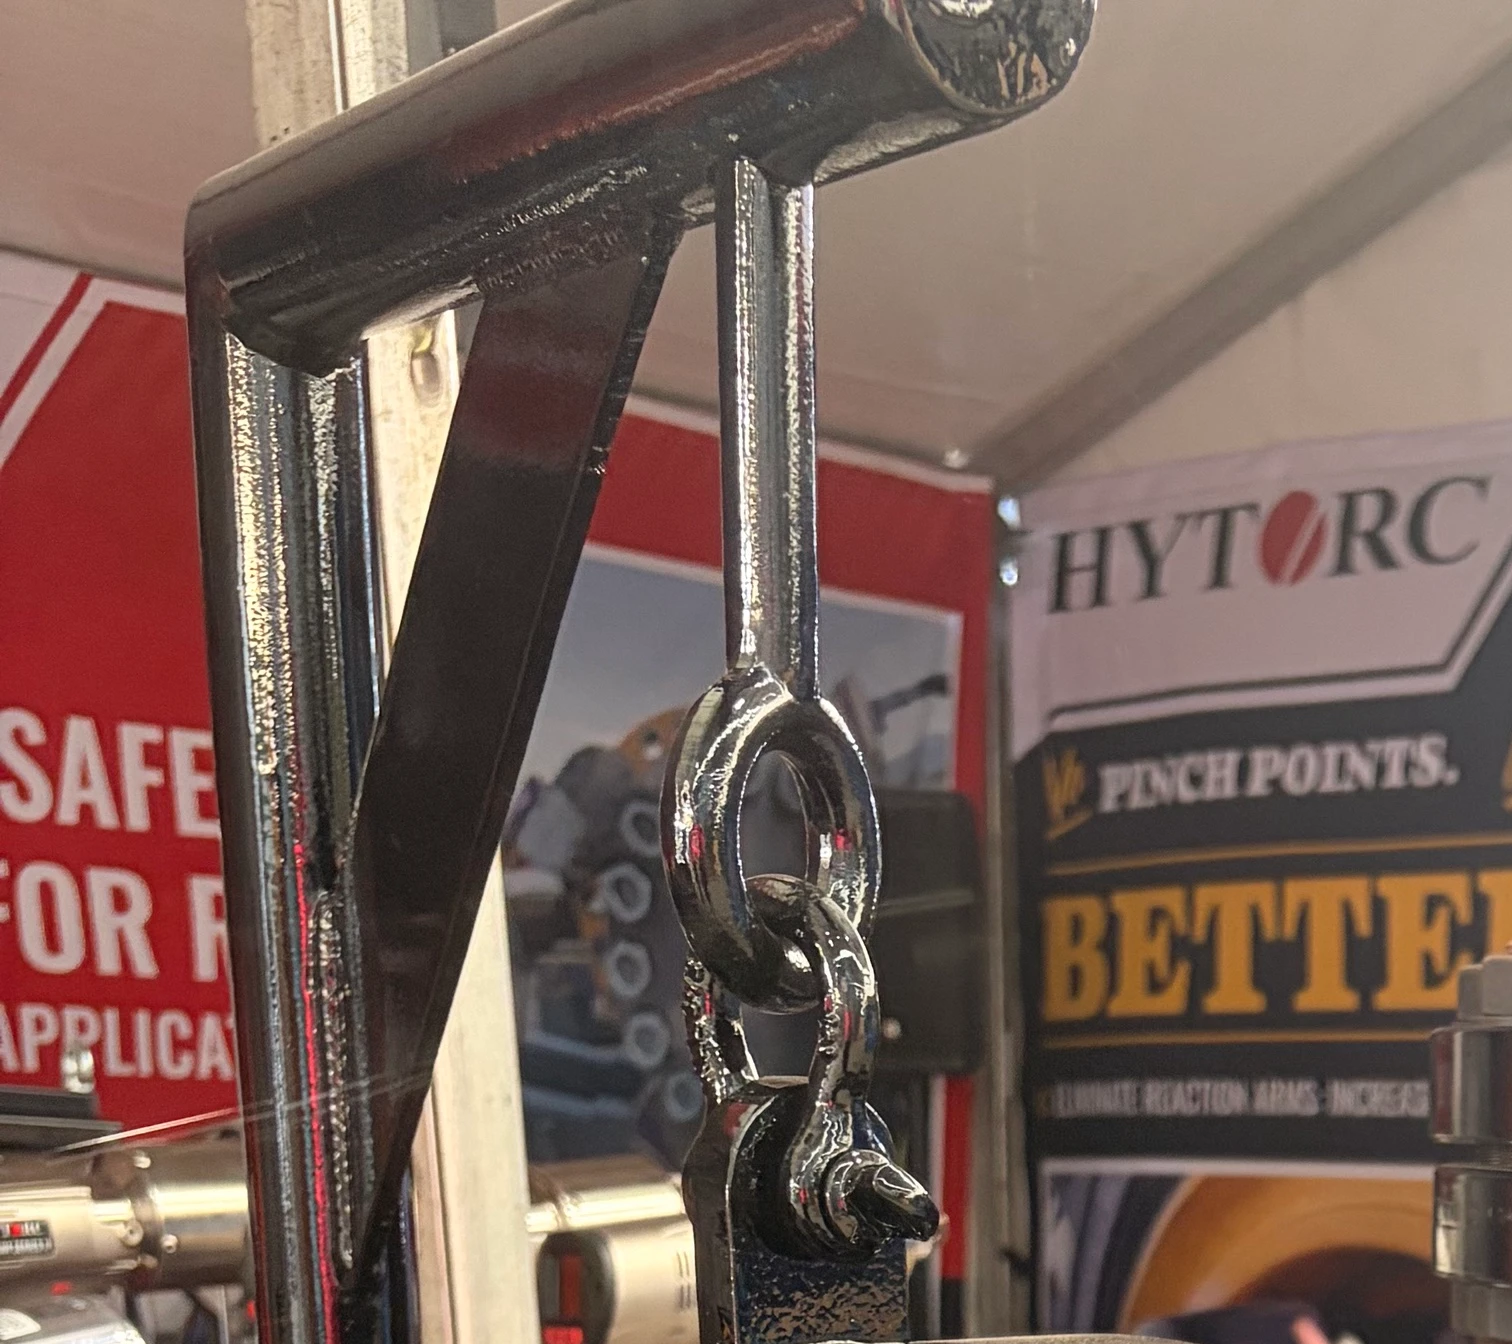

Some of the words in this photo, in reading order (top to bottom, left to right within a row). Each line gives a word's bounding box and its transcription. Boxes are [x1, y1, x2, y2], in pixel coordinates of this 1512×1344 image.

[1048, 475, 1494, 614] HYTORC
[1099, 747, 1243, 815] PINCH
[1245, 729, 1462, 797] POINTS.
